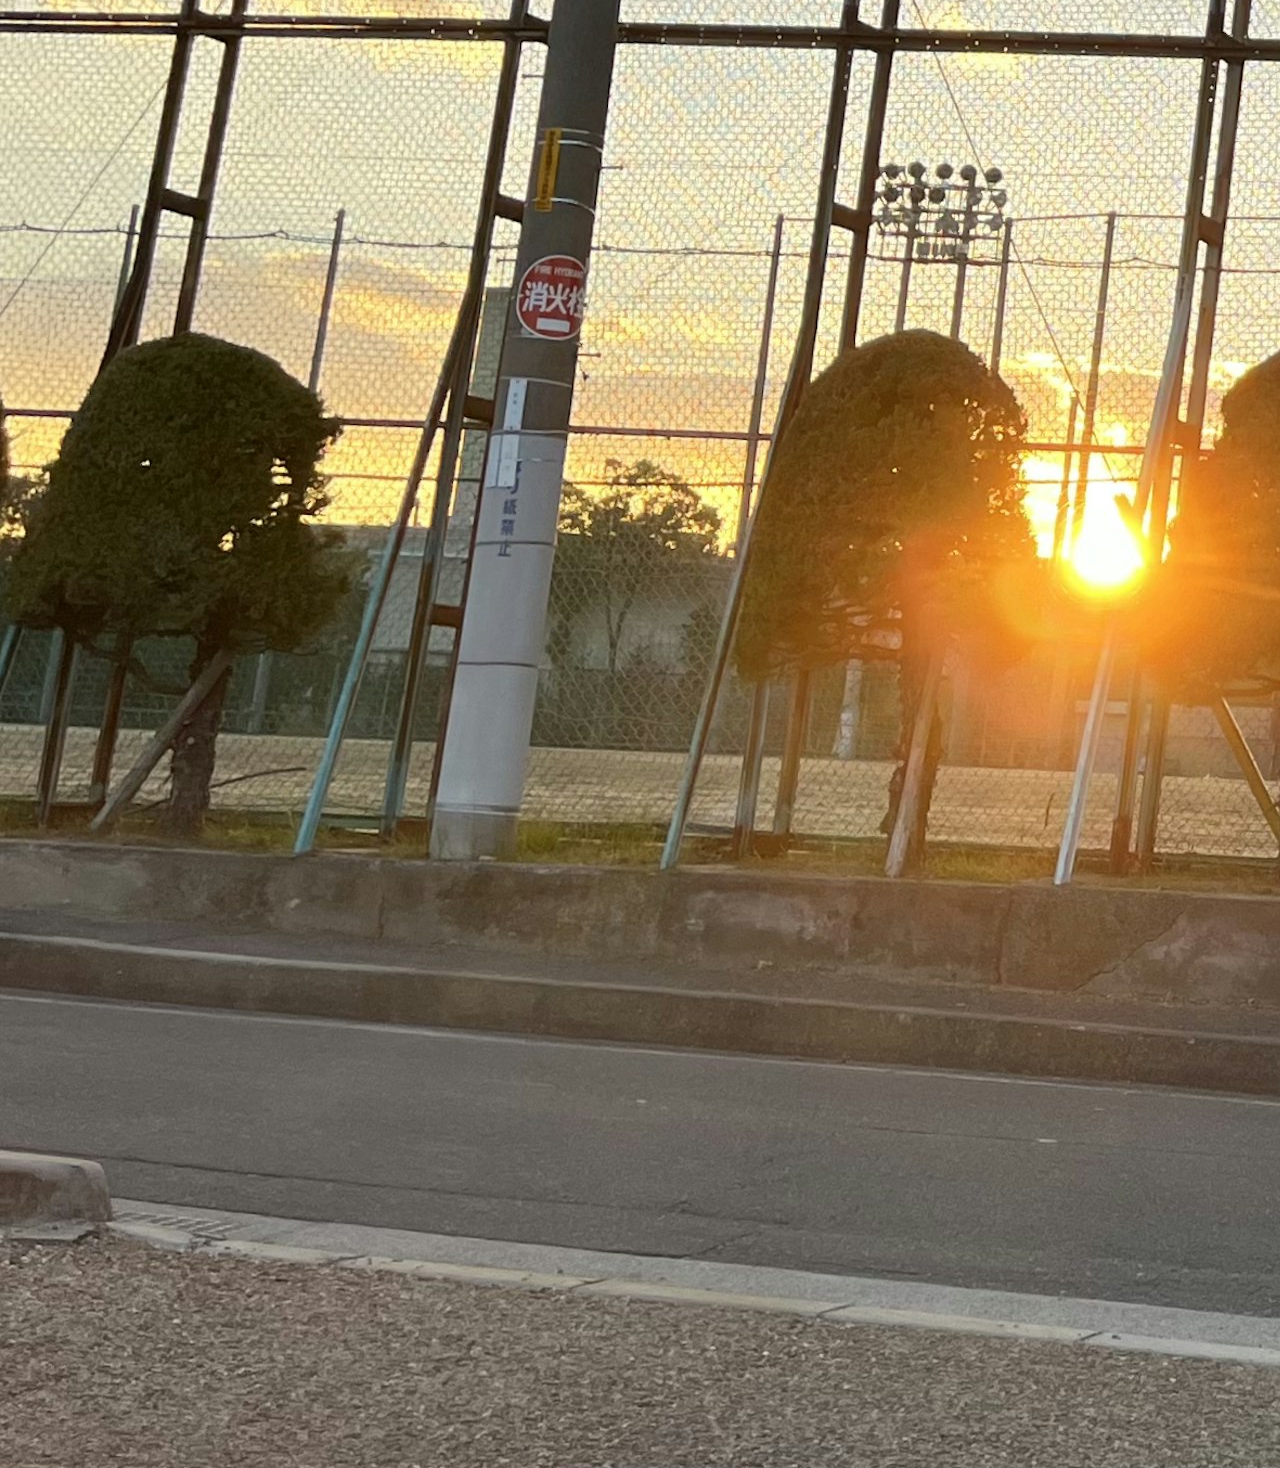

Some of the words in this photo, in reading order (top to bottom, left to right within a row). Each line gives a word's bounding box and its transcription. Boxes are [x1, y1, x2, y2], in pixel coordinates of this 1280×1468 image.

[535, 265, 553, 275] FIRE
[522, 281, 584, 319] 消火栓
[498, 460, 521, 557] り紙禁止
